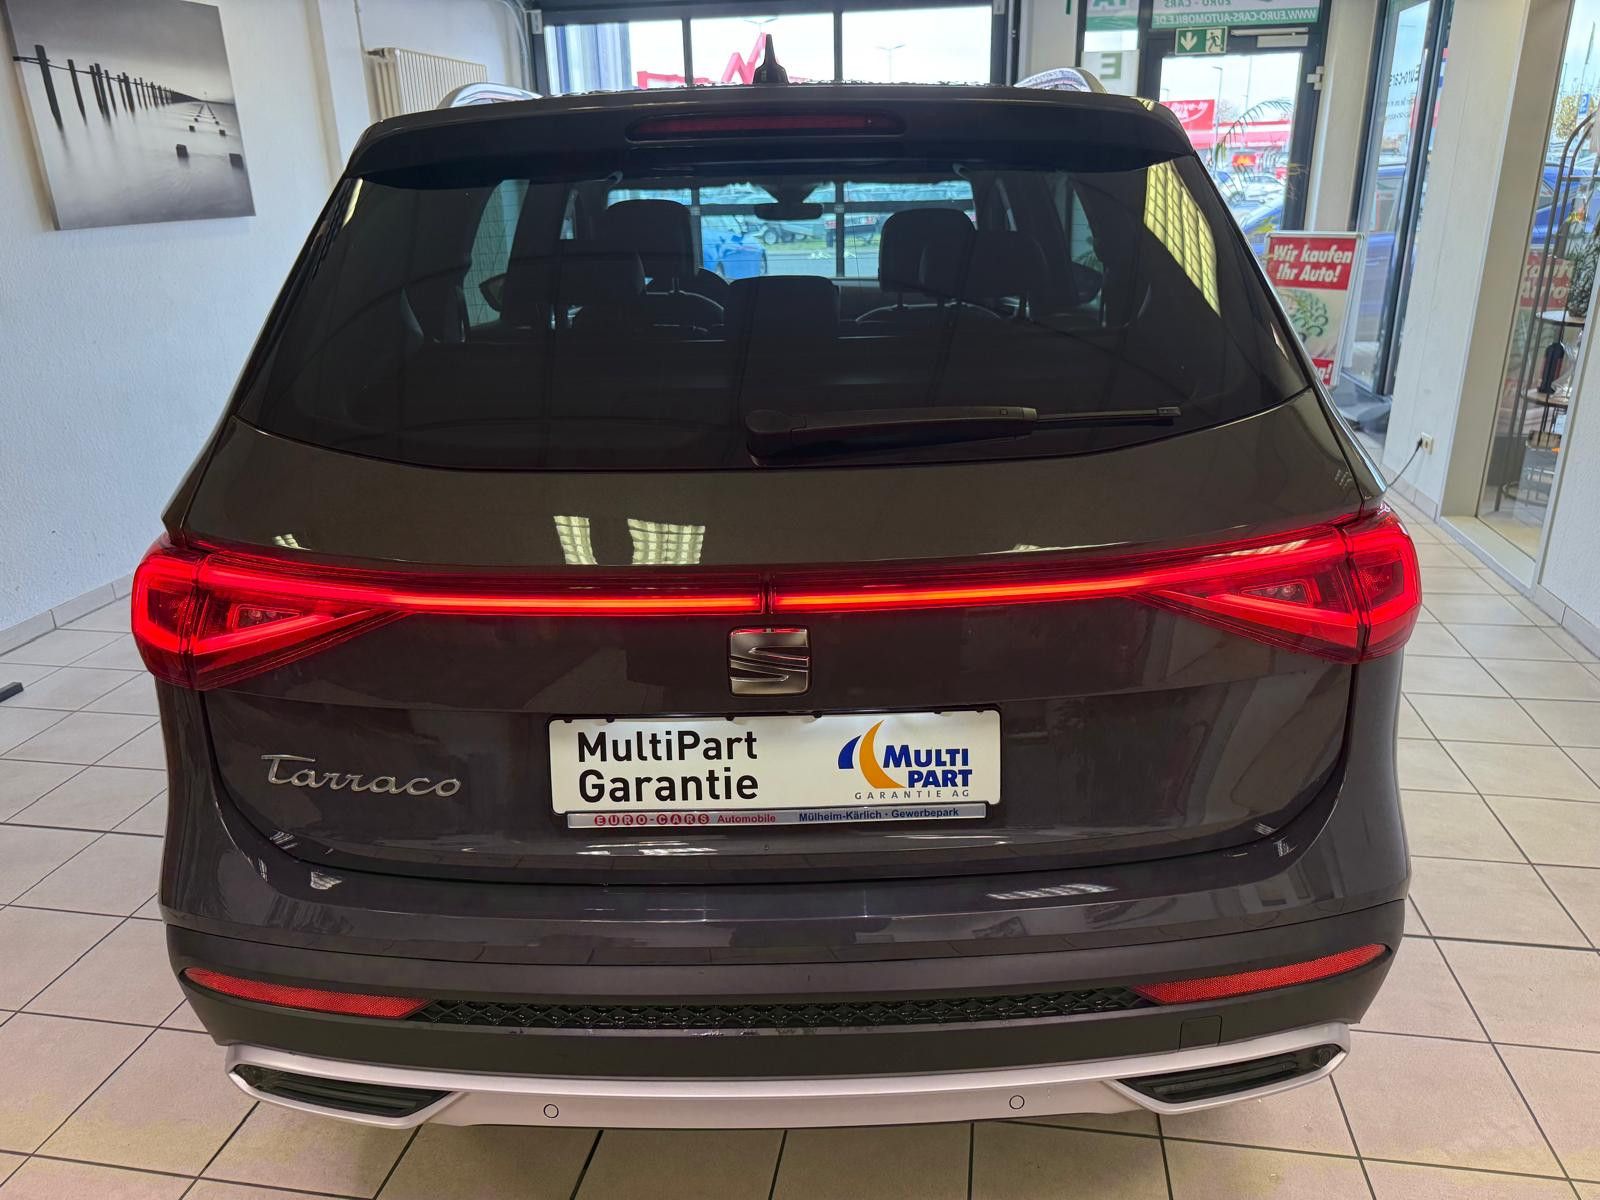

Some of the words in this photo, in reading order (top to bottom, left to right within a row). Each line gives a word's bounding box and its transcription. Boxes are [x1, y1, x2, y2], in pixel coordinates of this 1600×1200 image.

[1273, 244, 1299, 262] Wir
[1300, 243, 1353, 264] kaufen
[1276, 263, 1299, 280] Ihr
[1299, 265, 1342, 282] Auto!
[577, 730, 758, 763] MultiPart
[883, 745, 969, 768] MULTI
[261, 753, 462, 799] Tarraco
[578, 766, 759, 803] Garantie
[907, 769, 973, 788] PART
[855, 790, 943, 800] GARANTIE
[951, 789, 970, 798] AG
[594, 813, 710, 826] EURO-CARS
[717, 813, 776, 825] Automobile
[798, 809, 882, 822] Mülheim-Kärlich
[891, 807, 960, 820] Gewerbepark
